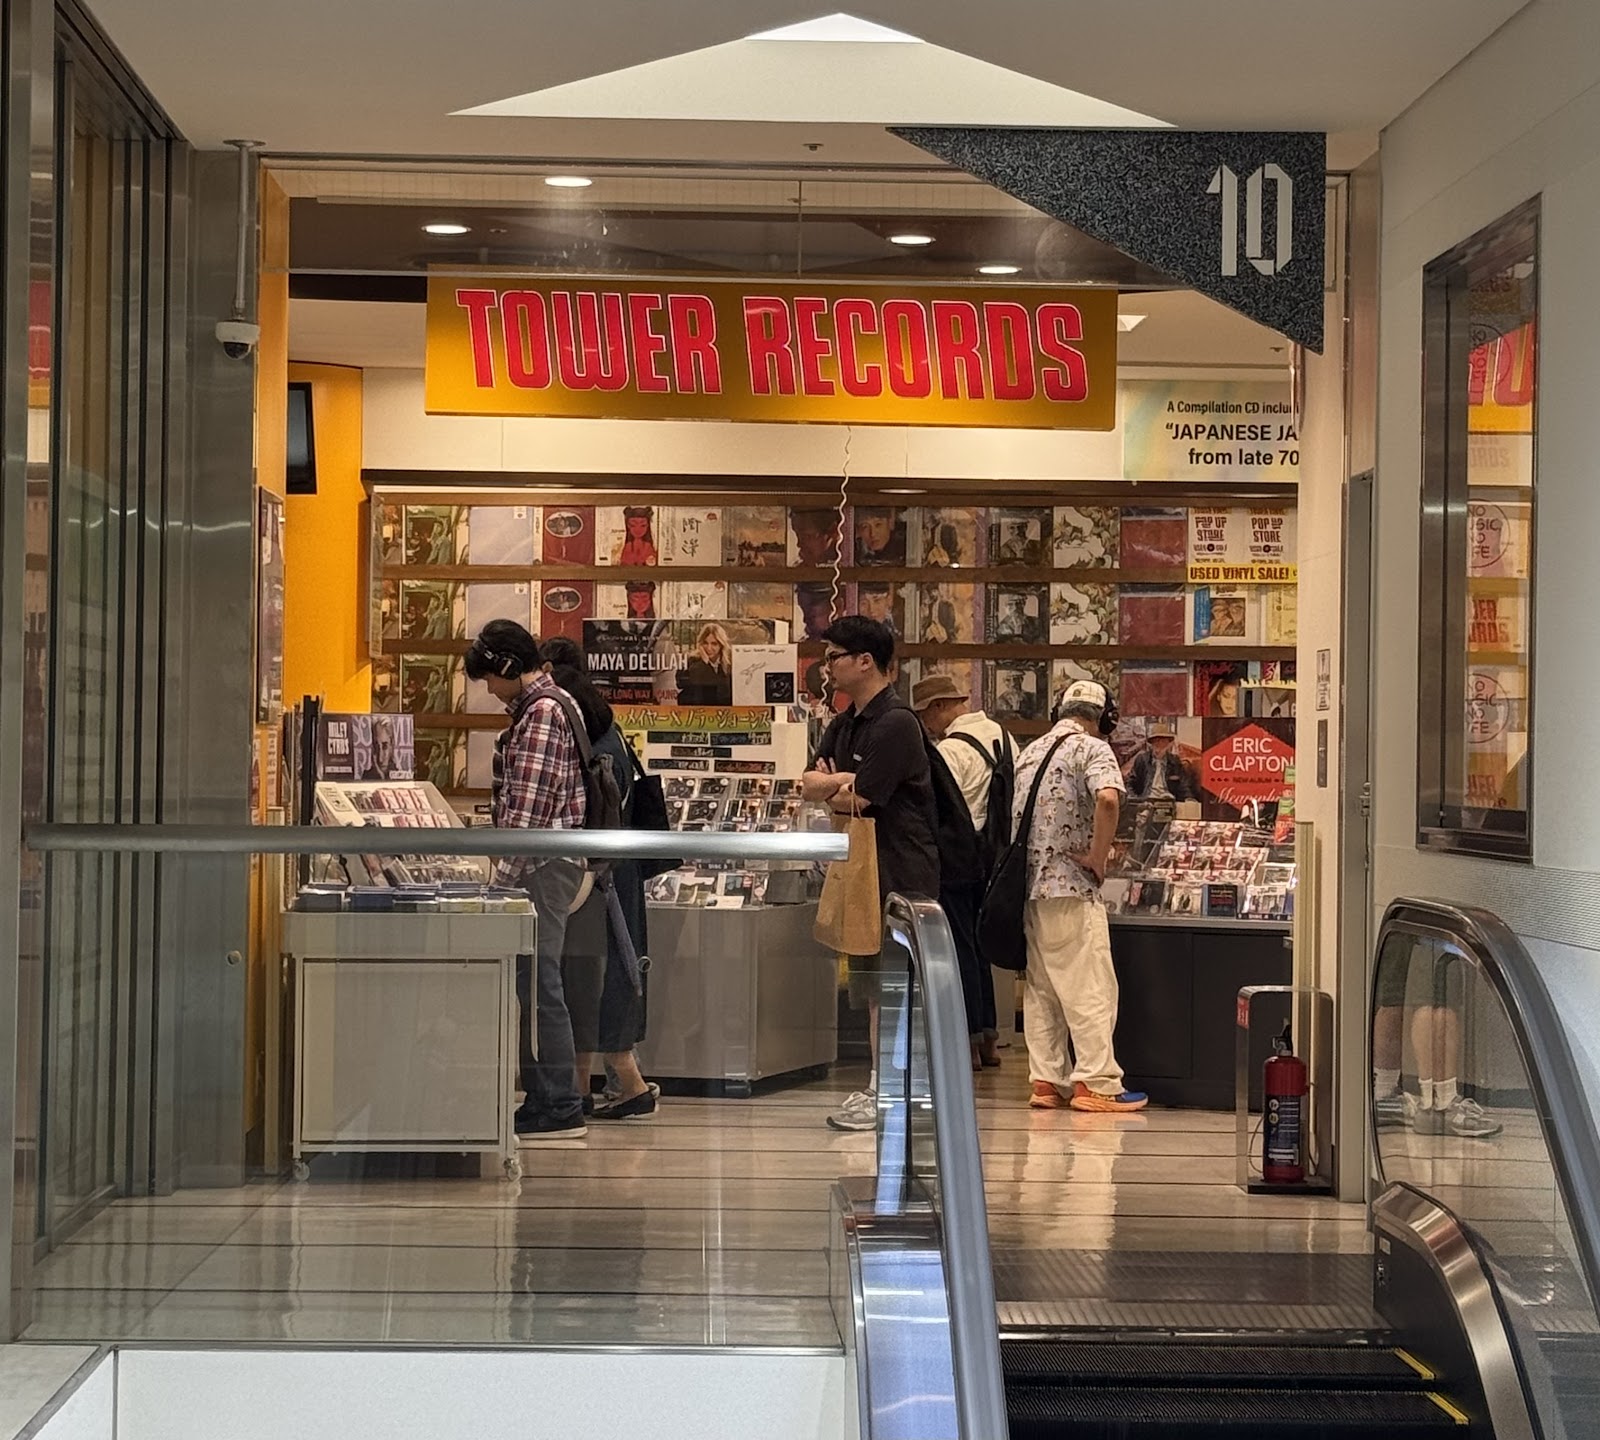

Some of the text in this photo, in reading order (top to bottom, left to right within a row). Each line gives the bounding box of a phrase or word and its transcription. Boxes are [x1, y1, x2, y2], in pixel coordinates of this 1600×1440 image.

[1205, 163, 1293, 276] 10
[456, 289, 1089, 402] TOWER RECORDS
[1167, 401, 1175, 413] A
[1177, 401, 1242, 415] Compilation
[1245, 402, 1260, 414] CD
[1188, 448, 1232, 465] from
[1239, 449, 1273, 465] late
[1195, 516, 1227, 529] POP UP
[1251, 517, 1284, 530] POP UP
[1196, 529, 1225, 542] STORE
[1253, 530, 1282, 543] STORE
[1190, 567, 1220, 580] USED
[1222, 567, 1255, 580] VINYL
[1258, 567, 1290, 580] SALE!
[587, 653, 689, 671] MAYA DELILAH
[1232, 737, 1272, 753] ERIC
[1209, 755, 1294, 772] CLAPTON
